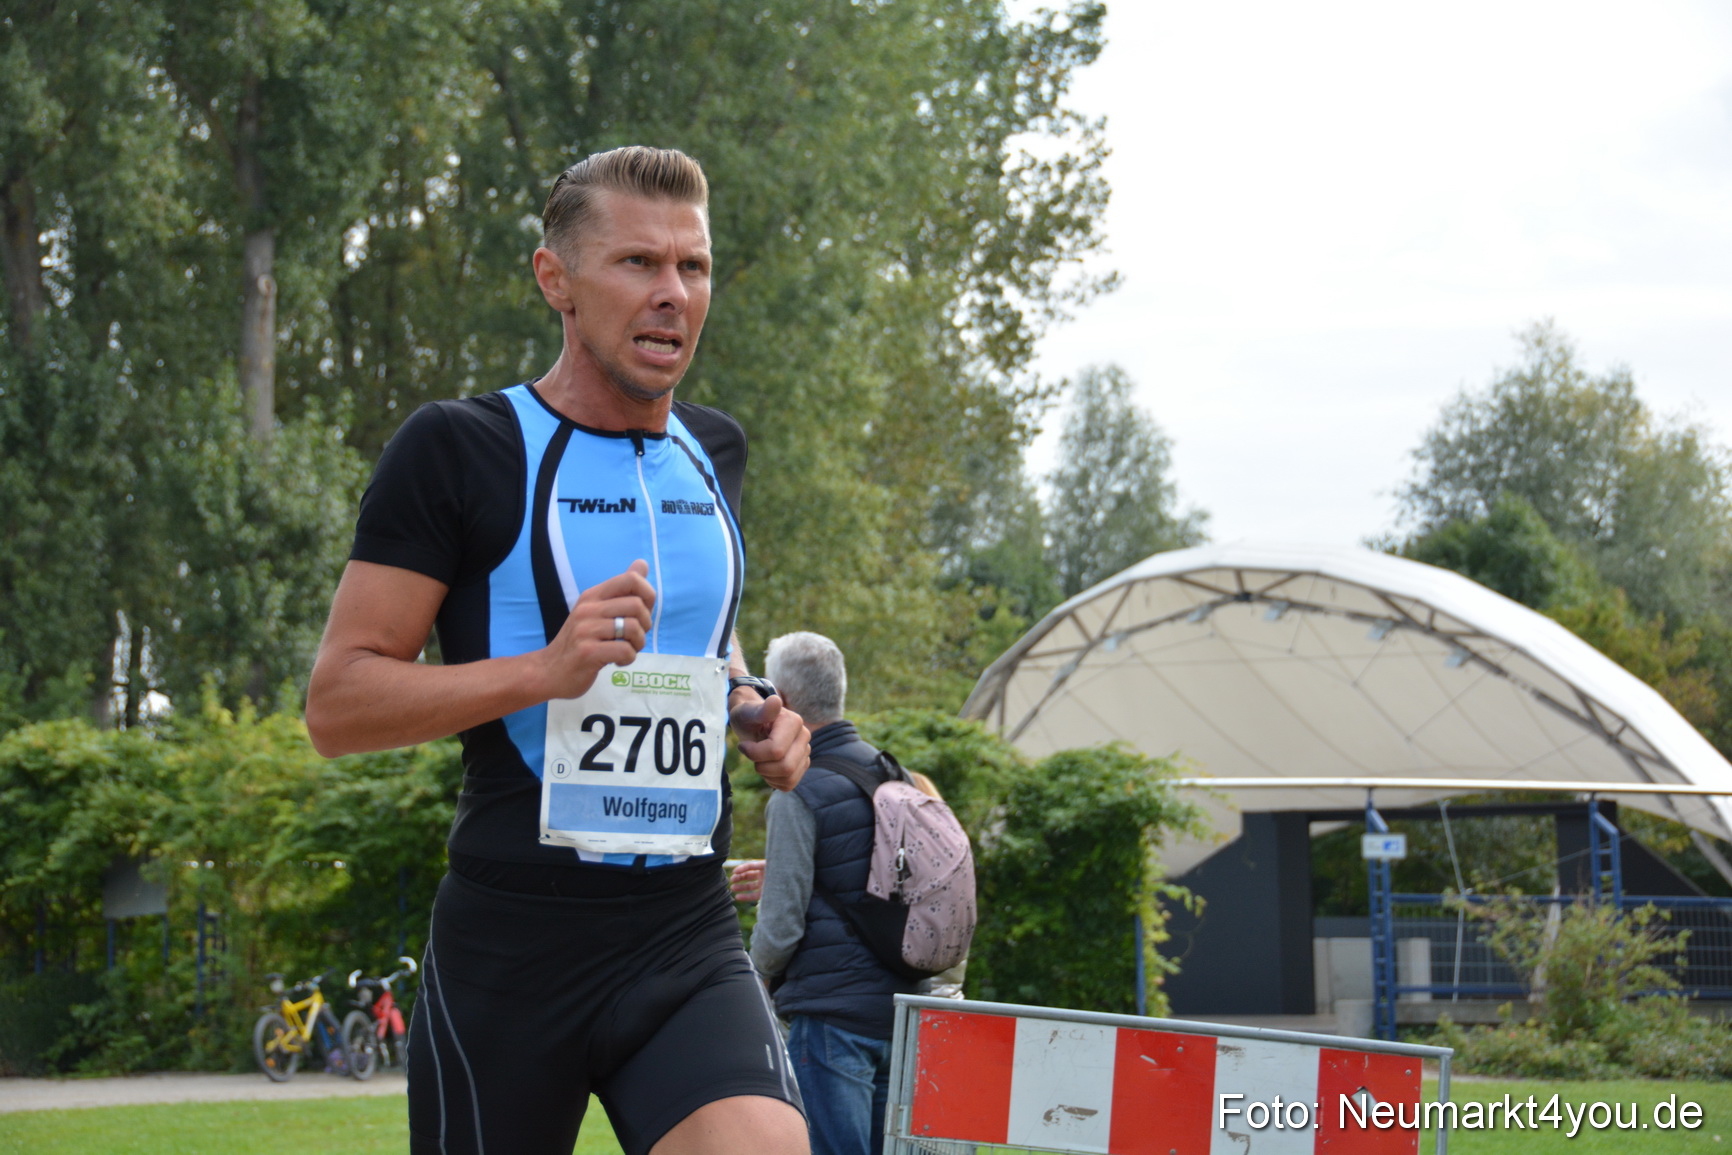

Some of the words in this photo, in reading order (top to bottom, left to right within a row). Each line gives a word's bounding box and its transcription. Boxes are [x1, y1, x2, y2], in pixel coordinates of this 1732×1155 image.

[632, 672, 691, 690] BOCK
[579, 714, 706, 776] 2706
[557, 763, 565, 774] D
[603, 796, 687, 823] Wolfgang
